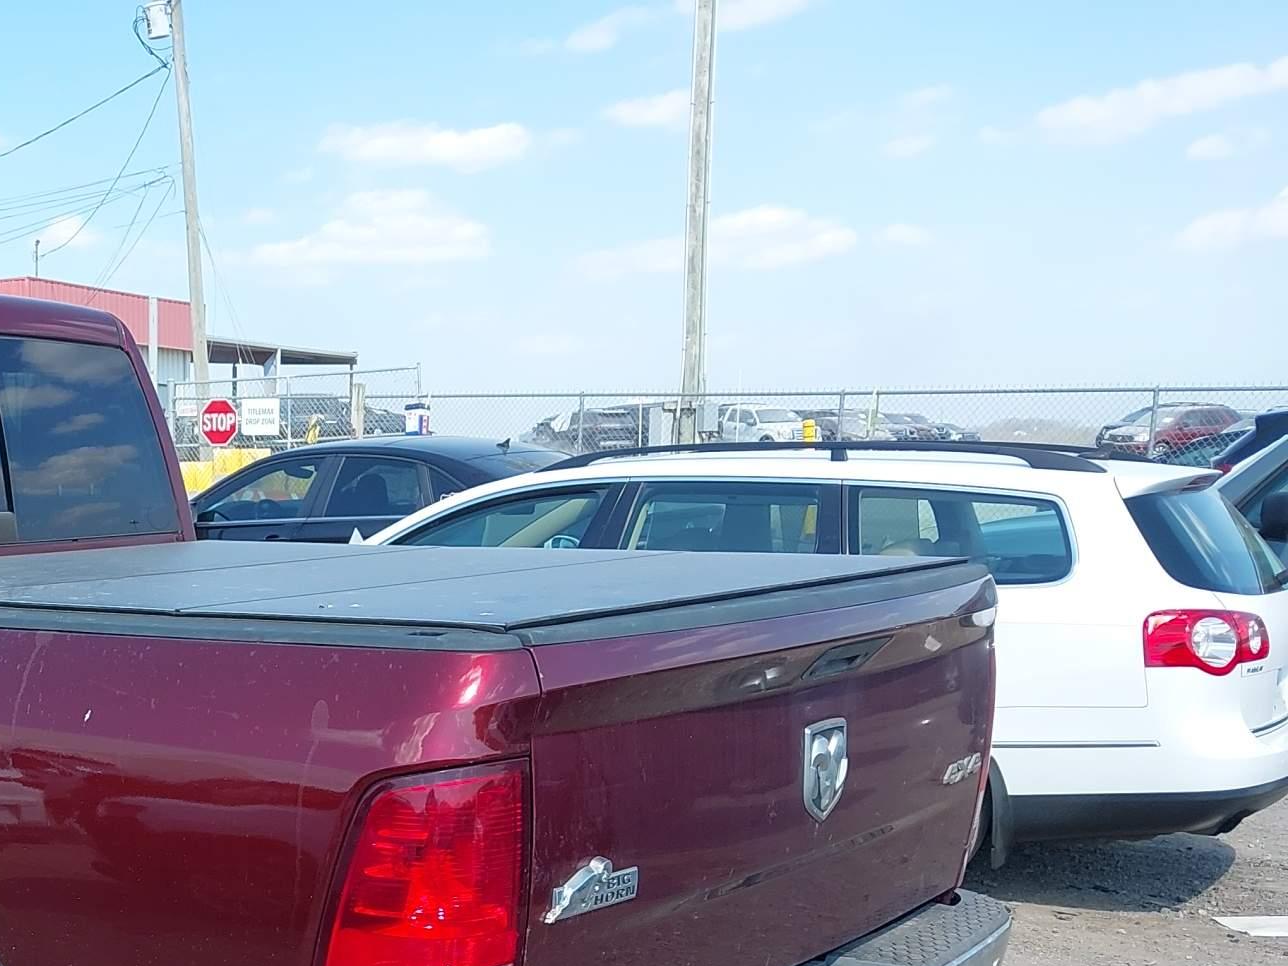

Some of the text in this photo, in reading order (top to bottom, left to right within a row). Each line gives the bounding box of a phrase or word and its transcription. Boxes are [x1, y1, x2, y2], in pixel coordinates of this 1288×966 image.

[203, 413, 236, 432] STOP
[607, 873, 632, 889] BIG
[594, 886, 635, 905] HORN
